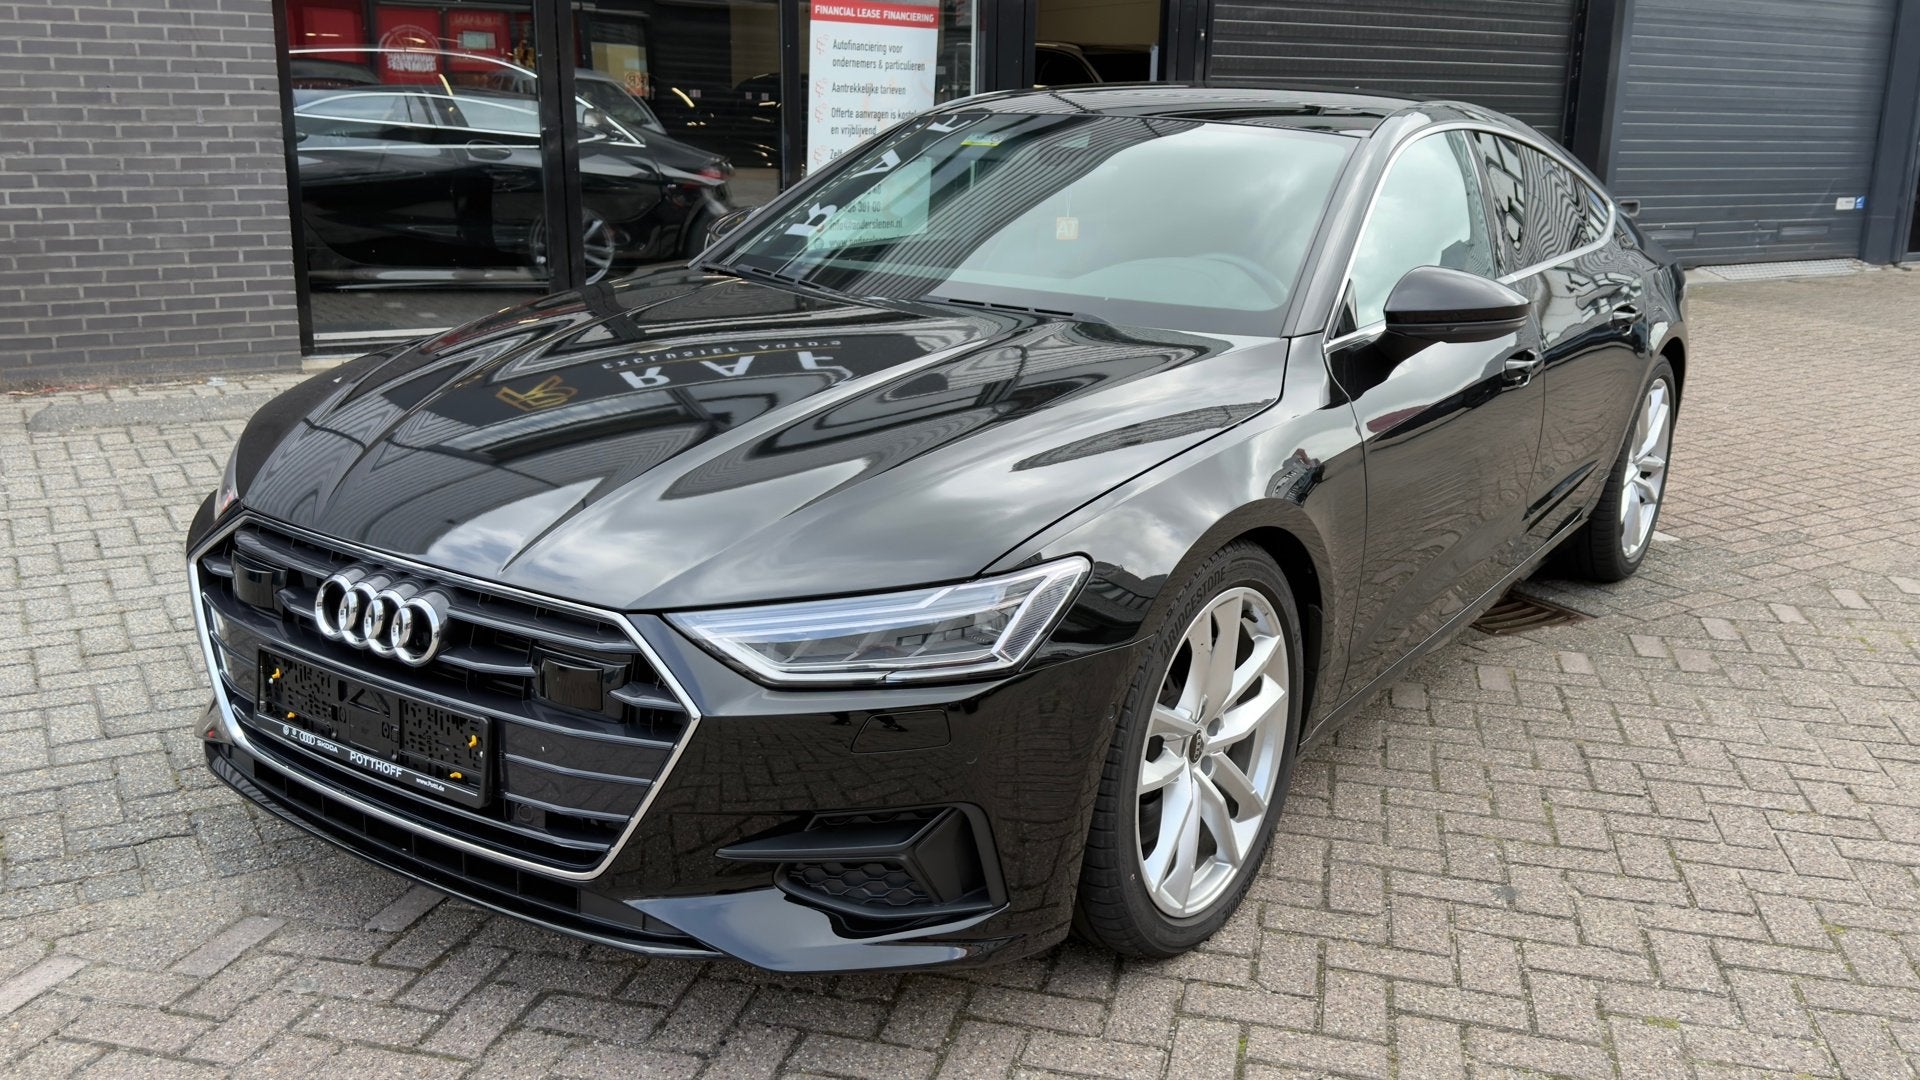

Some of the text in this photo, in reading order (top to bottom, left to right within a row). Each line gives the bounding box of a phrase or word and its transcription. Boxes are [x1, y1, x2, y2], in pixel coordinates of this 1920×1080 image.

[815, 5, 934, 23] FINANCIAL LEASE FINANCIERING
[833, 39, 903, 55] Autofinanciering voor
[832, 57, 925, 72] ondernemers & particulieren
[832, 82, 906, 96] Aantrekkelijke tarieven
[832, 107, 854, 119] Offerte
[855, 110, 889, 121] aanvragen
[891, 110, 896, 119] is
[831, 125, 877, 137] en vrijblijvend
[350, 751, 403, 778] POTTHOFF
